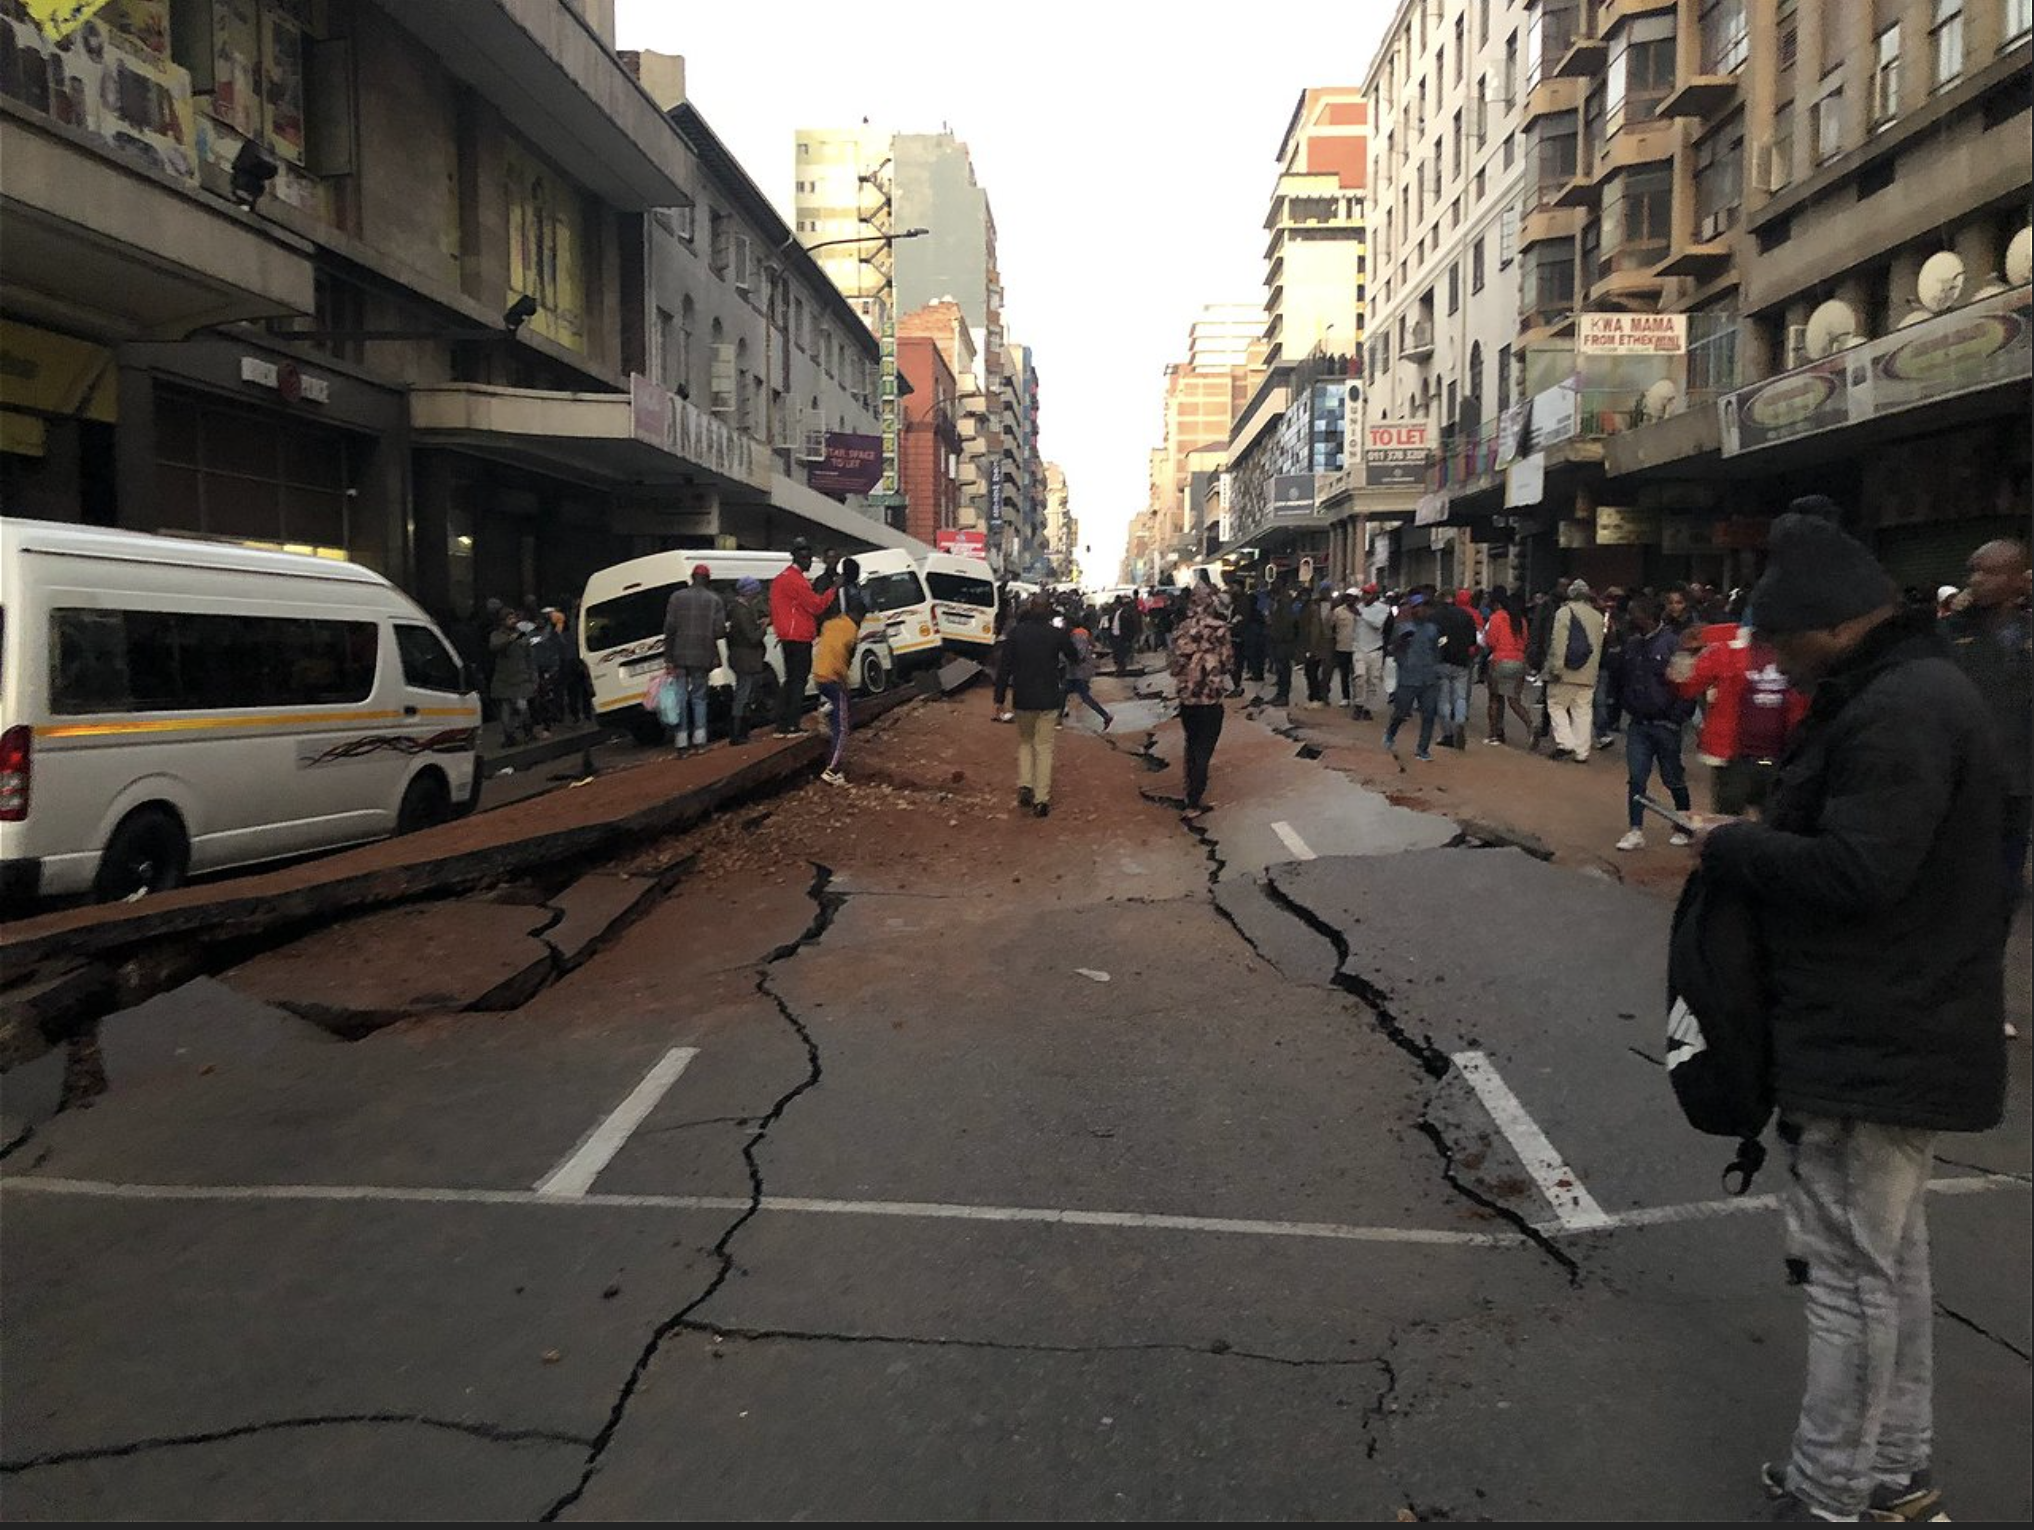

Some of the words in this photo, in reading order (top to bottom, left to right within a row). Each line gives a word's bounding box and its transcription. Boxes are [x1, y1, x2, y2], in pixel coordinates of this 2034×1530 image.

[1590, 318, 1623, 333] KWA
[1630, 317, 1675, 333] MAMA
[1583, 334, 1616, 346] FROM
[1349, 406, 1358, 459] UNION
[1370, 429, 1393, 446] TO
[1397, 428, 1426, 445] LET
